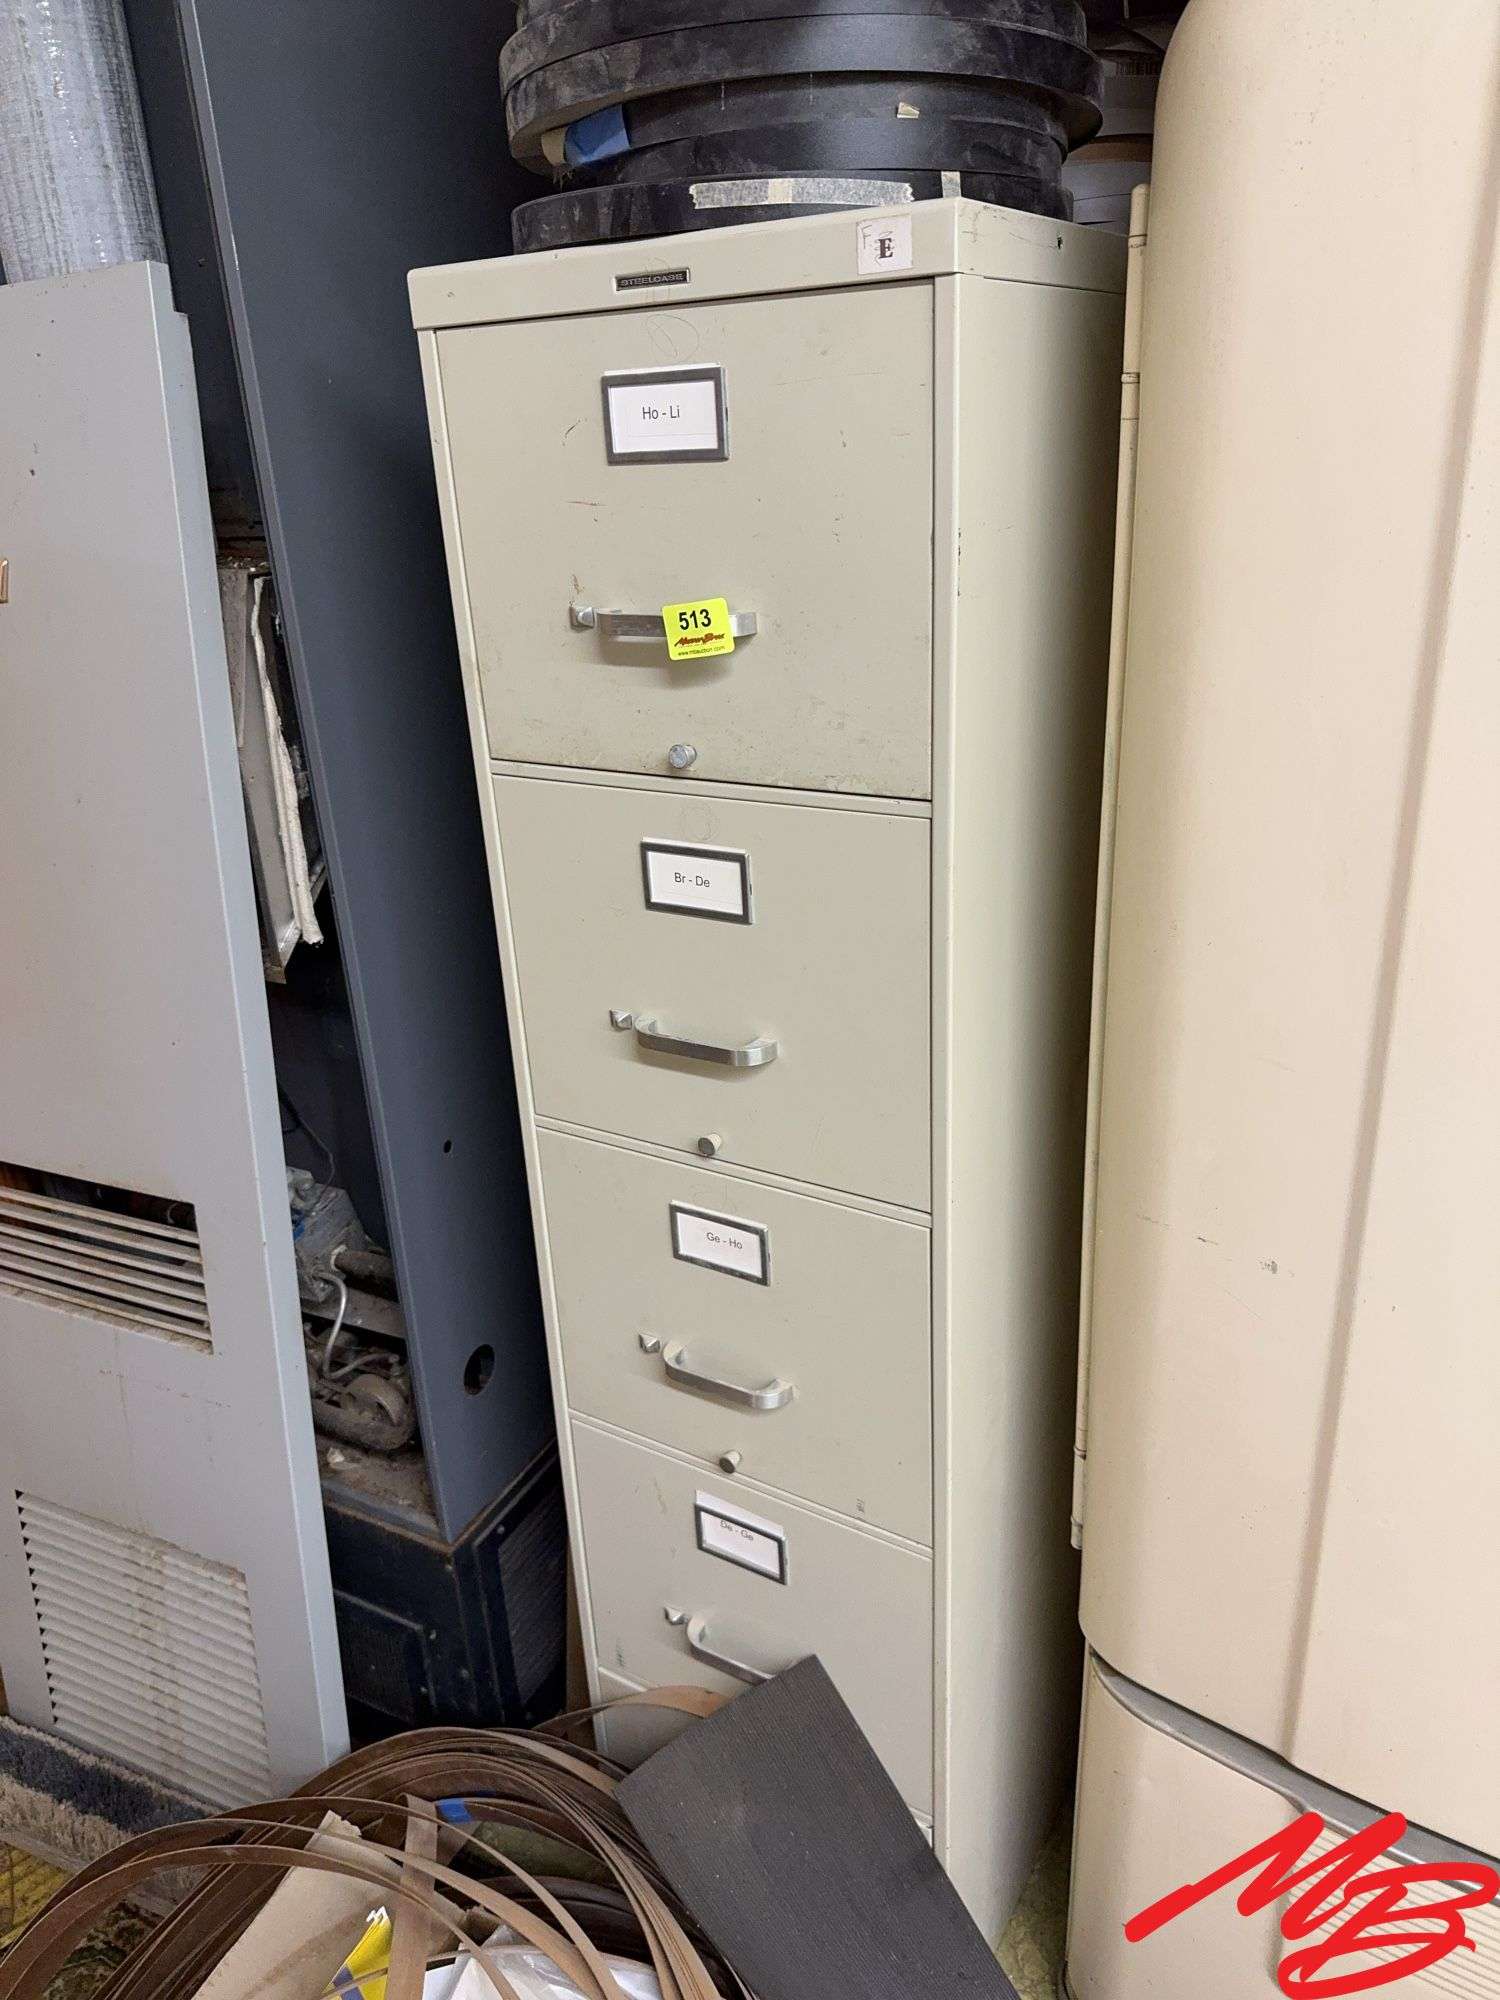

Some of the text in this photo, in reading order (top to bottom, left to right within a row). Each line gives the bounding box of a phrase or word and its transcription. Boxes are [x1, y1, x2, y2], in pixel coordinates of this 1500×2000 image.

[878, 237, 894, 259] E
[621, 273, 684, 287] STEELCASE
[642, 406, 659, 420] Ho
[669, 405, 680, 419] Li
[678, 608, 712, 631] 513
[674, 872, 686, 884] Br
[695, 875, 710, 888] De
[706, 1231, 720, 1243] Ge
[728, 1238, 743, 1249] Ho
